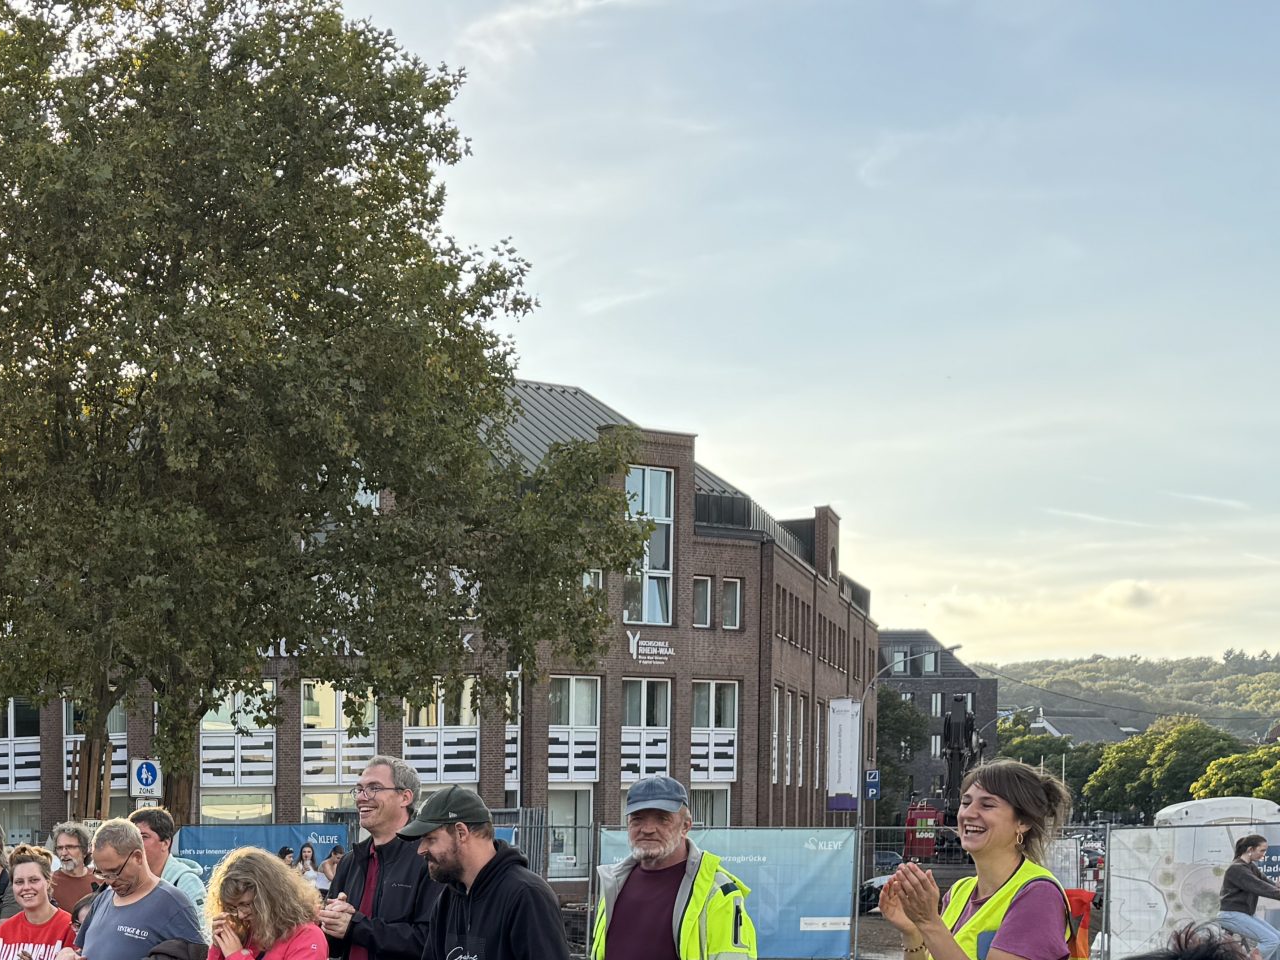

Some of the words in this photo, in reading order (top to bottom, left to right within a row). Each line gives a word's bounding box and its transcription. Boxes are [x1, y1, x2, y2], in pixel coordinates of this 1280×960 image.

[869, 788, 877, 797] P
[318, 835, 338, 843] KLEVE
[818, 841, 843, 850] KLEVE
[720, 854, 767, 864] erzogbrücke
